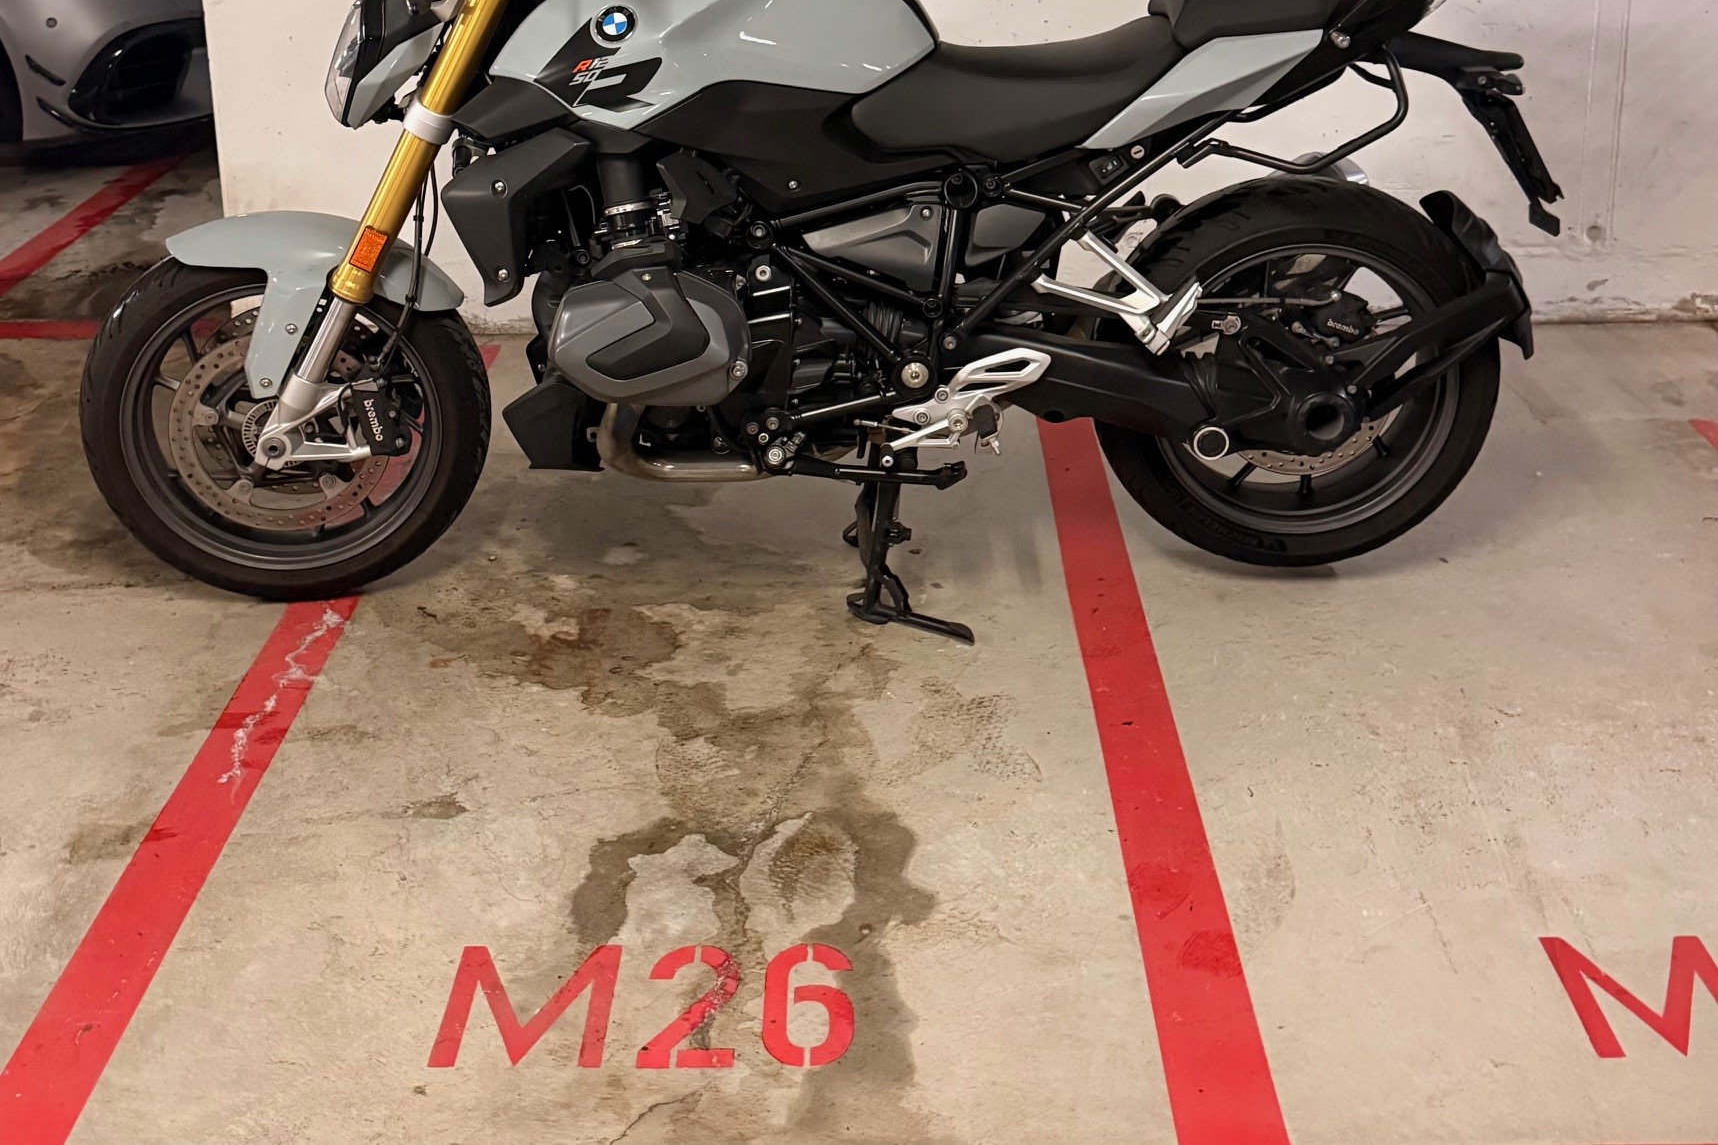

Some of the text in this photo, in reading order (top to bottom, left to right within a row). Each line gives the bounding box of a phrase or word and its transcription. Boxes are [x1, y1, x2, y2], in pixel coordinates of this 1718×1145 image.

[1327, 318, 1359, 335] brembo
[363, 398, 383, 441] brembo
[427, 943, 855, 1069] M26
